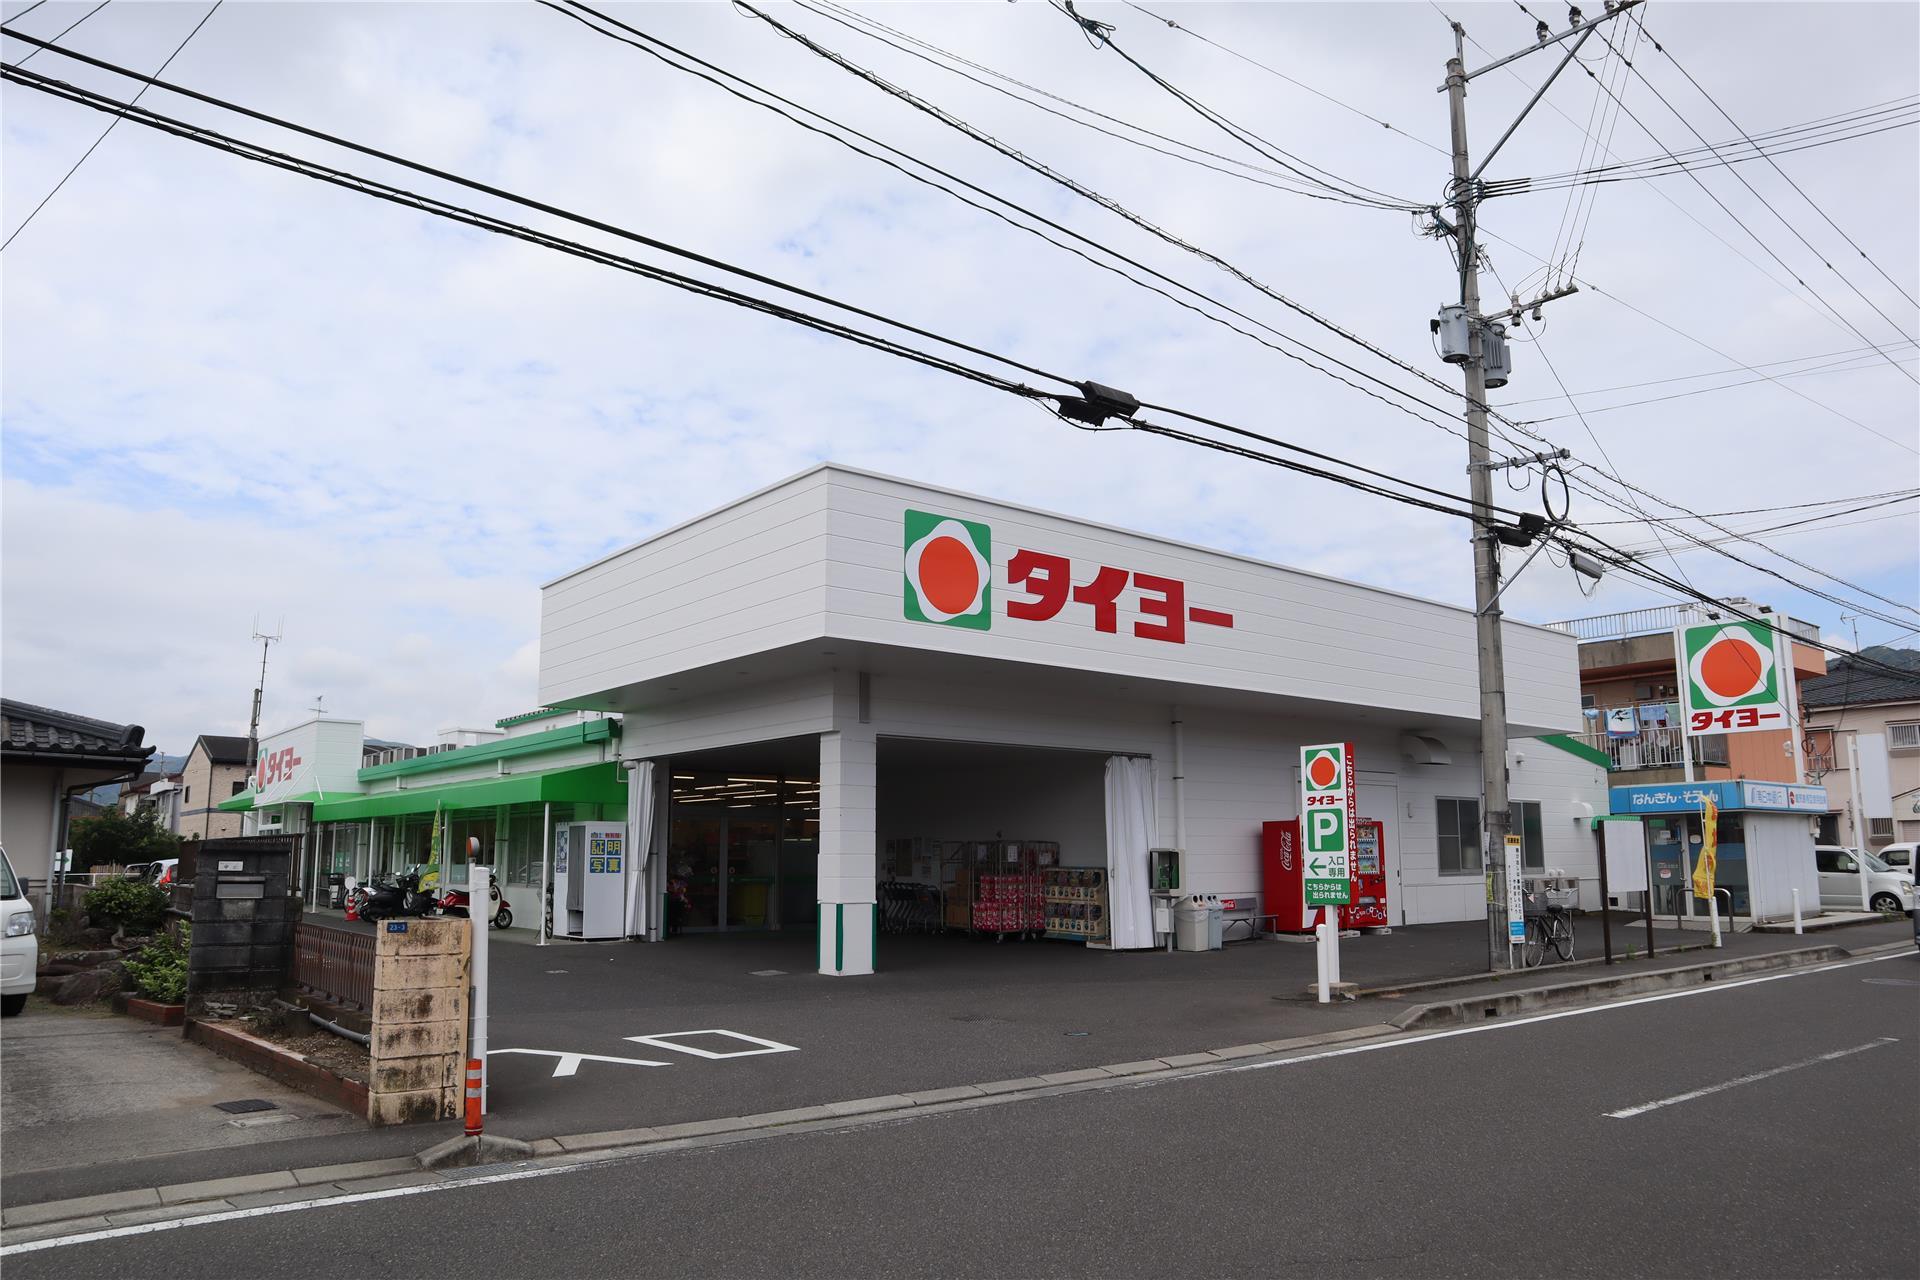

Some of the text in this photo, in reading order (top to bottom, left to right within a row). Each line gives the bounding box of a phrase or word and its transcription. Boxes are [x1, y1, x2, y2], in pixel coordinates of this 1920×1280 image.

[1007, 548, 1234, 644] タイヨー
[1691, 708, 1780, 731] タイヨー
[266, 746, 302, 785] タイヨー
[1307, 795, 1344, 806] タイヨー
[1346, 755, 1358, 882] こちらからは出られません
[1313, 812, 1339, 850] P
[591, 840, 621, 855] 証明
[590, 858, 621, 873] 写真
[1328, 856, 1345, 866] 入口
[1328, 868, 1346, 878] 専用
[1307, 883, 1342, 891] こちらからは
[1312, 890, 1348, 899] 出られません
